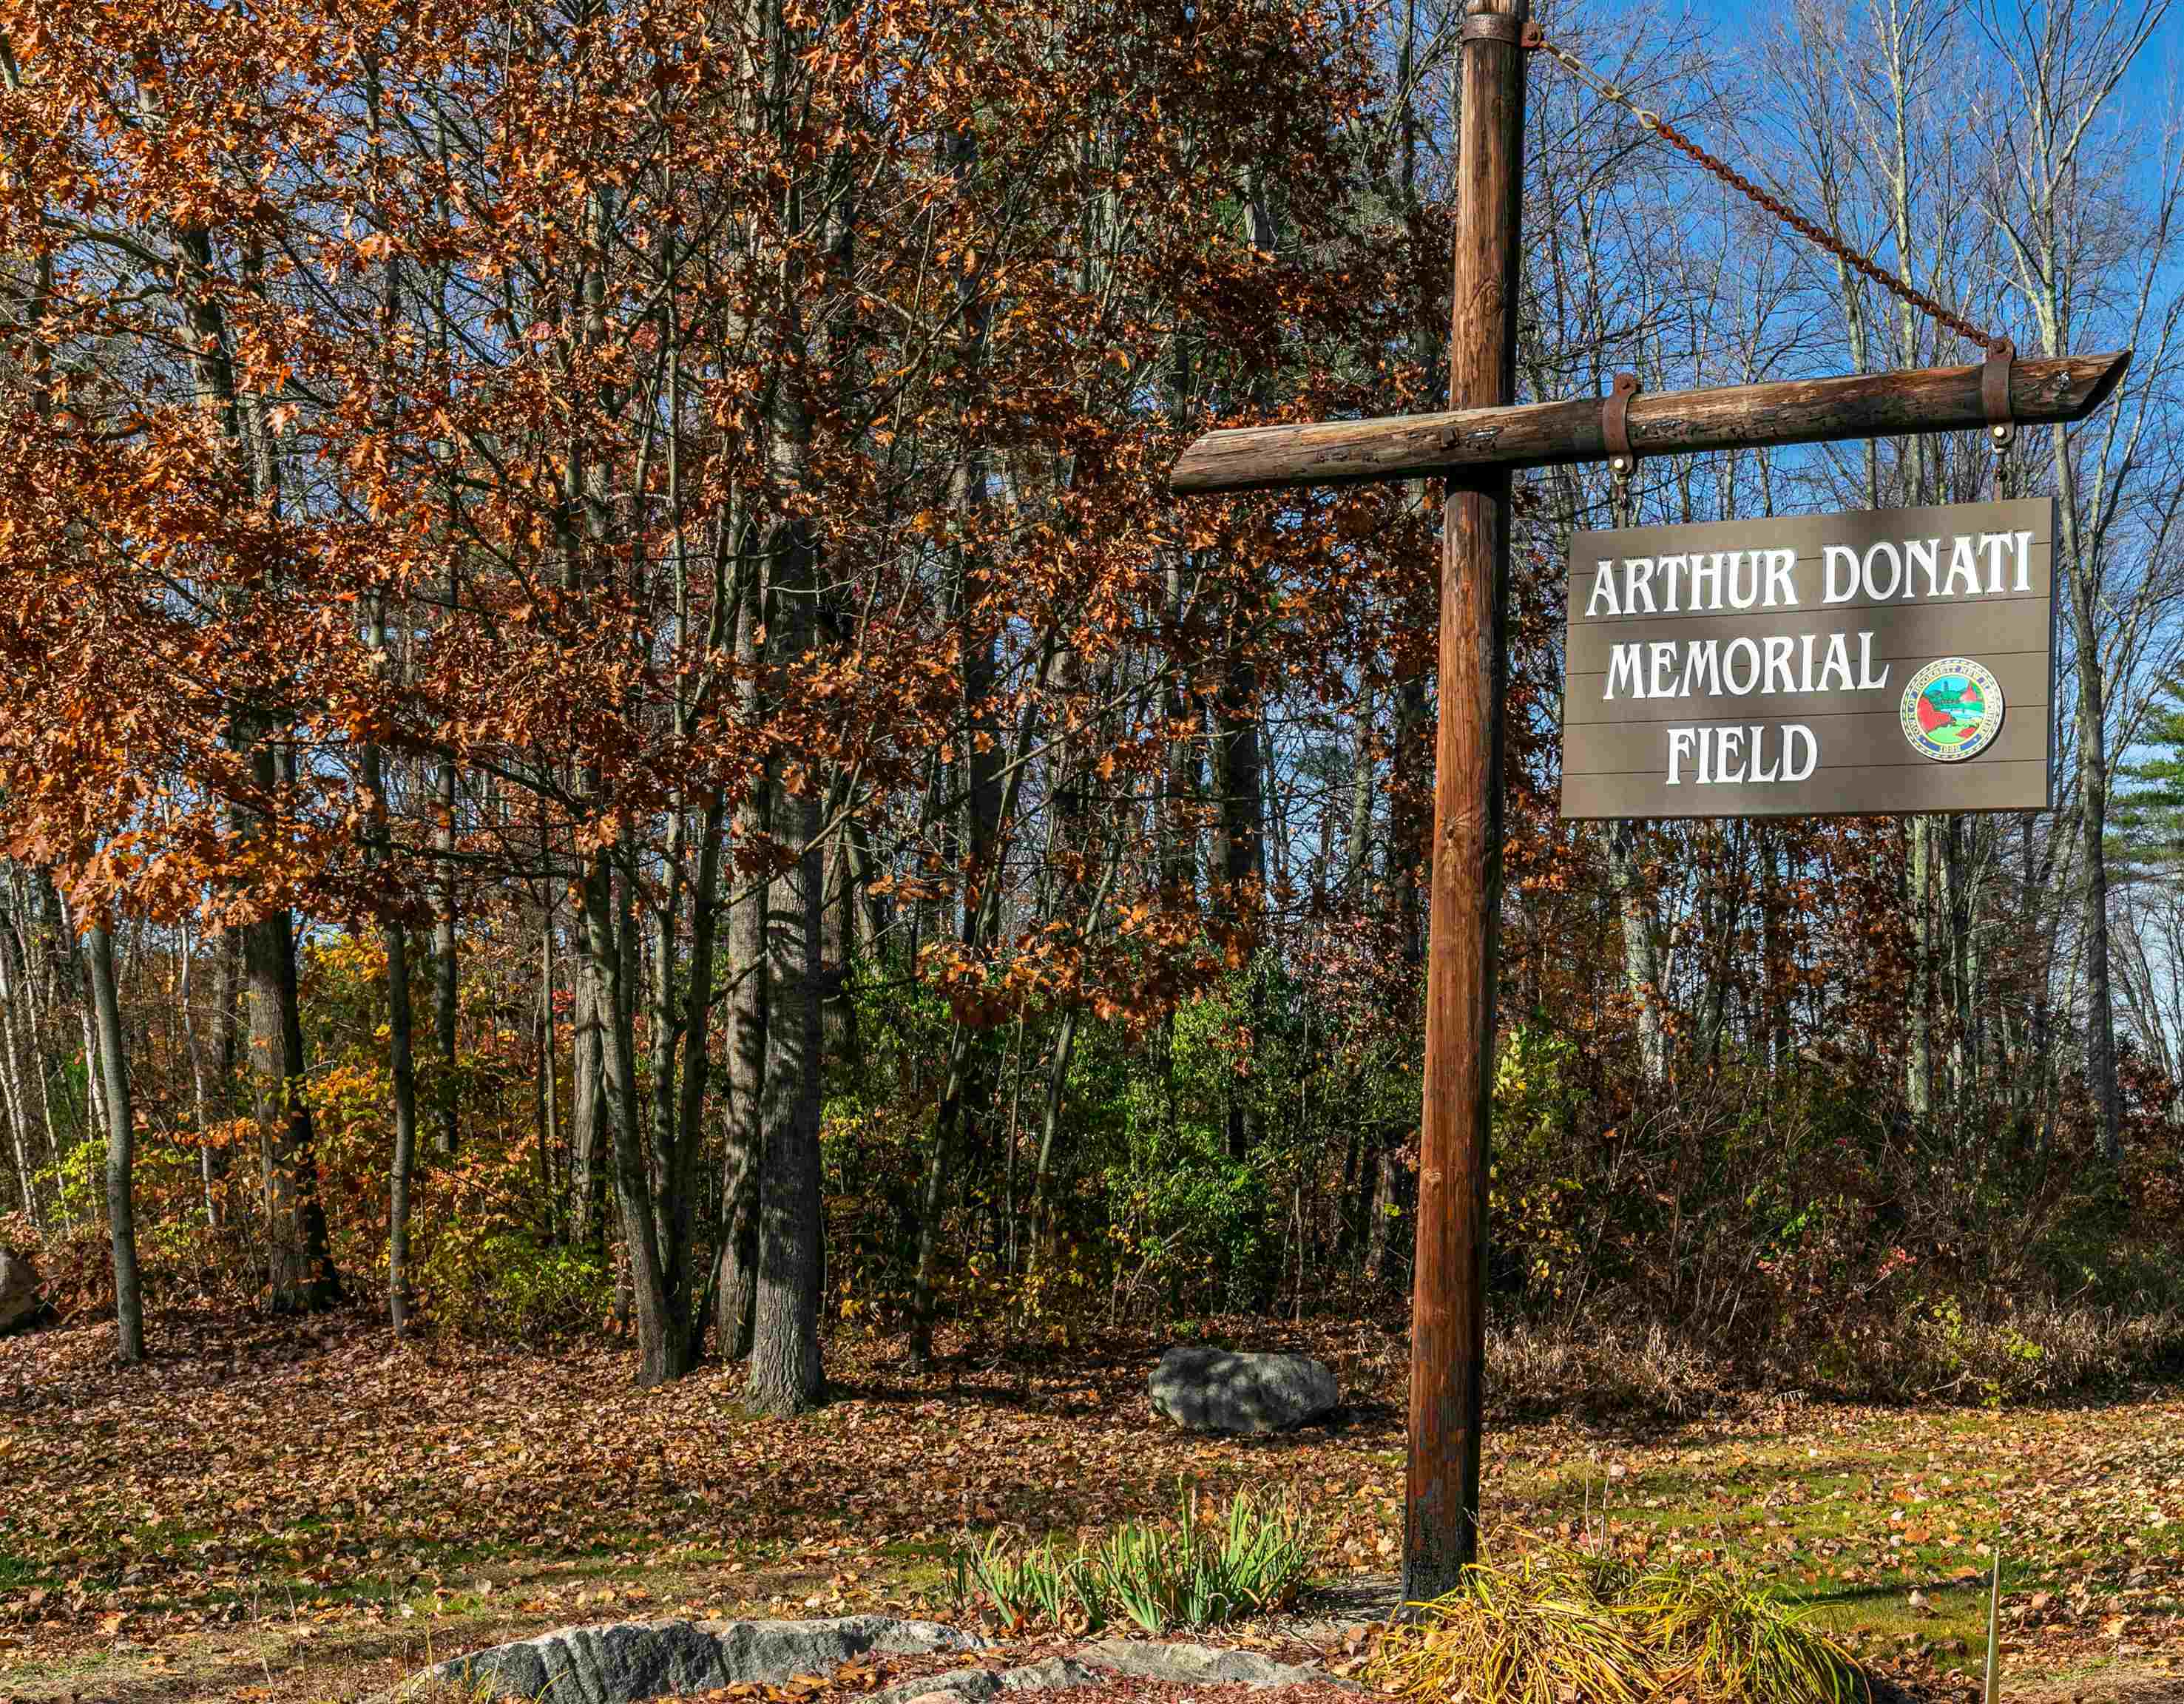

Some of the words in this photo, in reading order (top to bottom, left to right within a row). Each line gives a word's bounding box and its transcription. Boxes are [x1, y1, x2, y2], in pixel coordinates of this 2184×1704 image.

[1585, 548, 1799, 616] ARTHUR
[1822, 531, 2034, 604] DONATI
[1603, 632, 1890, 700] MEMORIAL
[1666, 724, 1818, 785] FIELD
